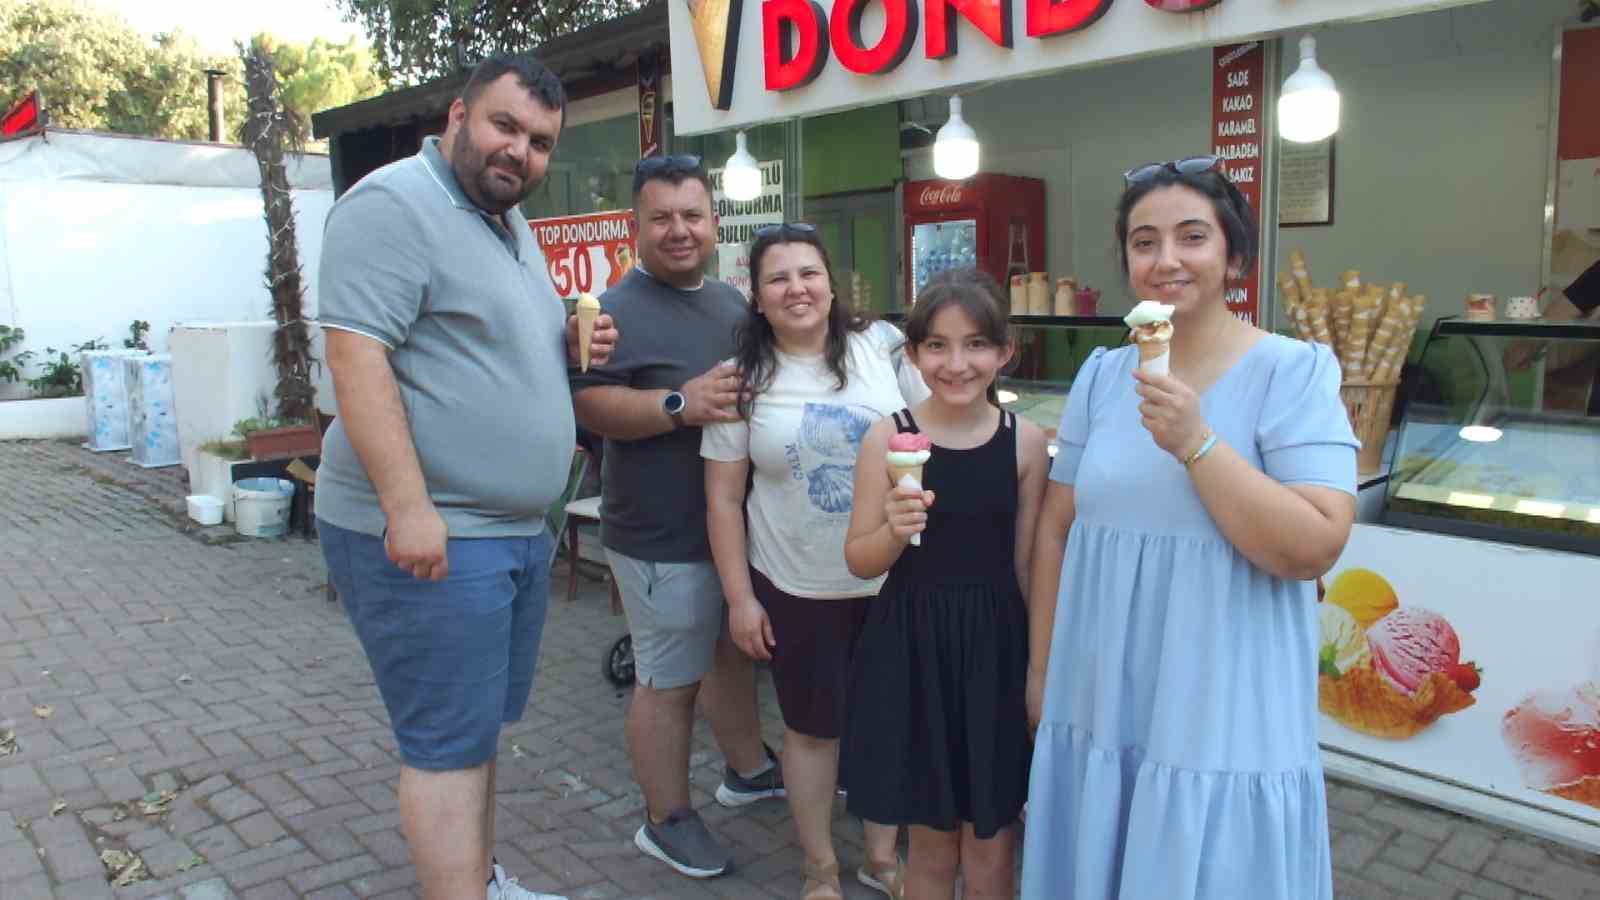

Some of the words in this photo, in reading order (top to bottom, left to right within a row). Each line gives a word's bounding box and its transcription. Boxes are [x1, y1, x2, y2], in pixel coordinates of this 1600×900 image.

[1227, 70, 1249, 88] SADE
[1222, 95, 1253, 113] KAKAO
[1218, 118, 1256, 137] KARAMEL
[1215, 143, 1258, 160] BALBADEM
[920, 184, 961, 206] Coca-Cola
[541, 225, 561, 245] TOP
[562, 218, 629, 243] DONDURMA
[784, 442, 804, 481] CALM
